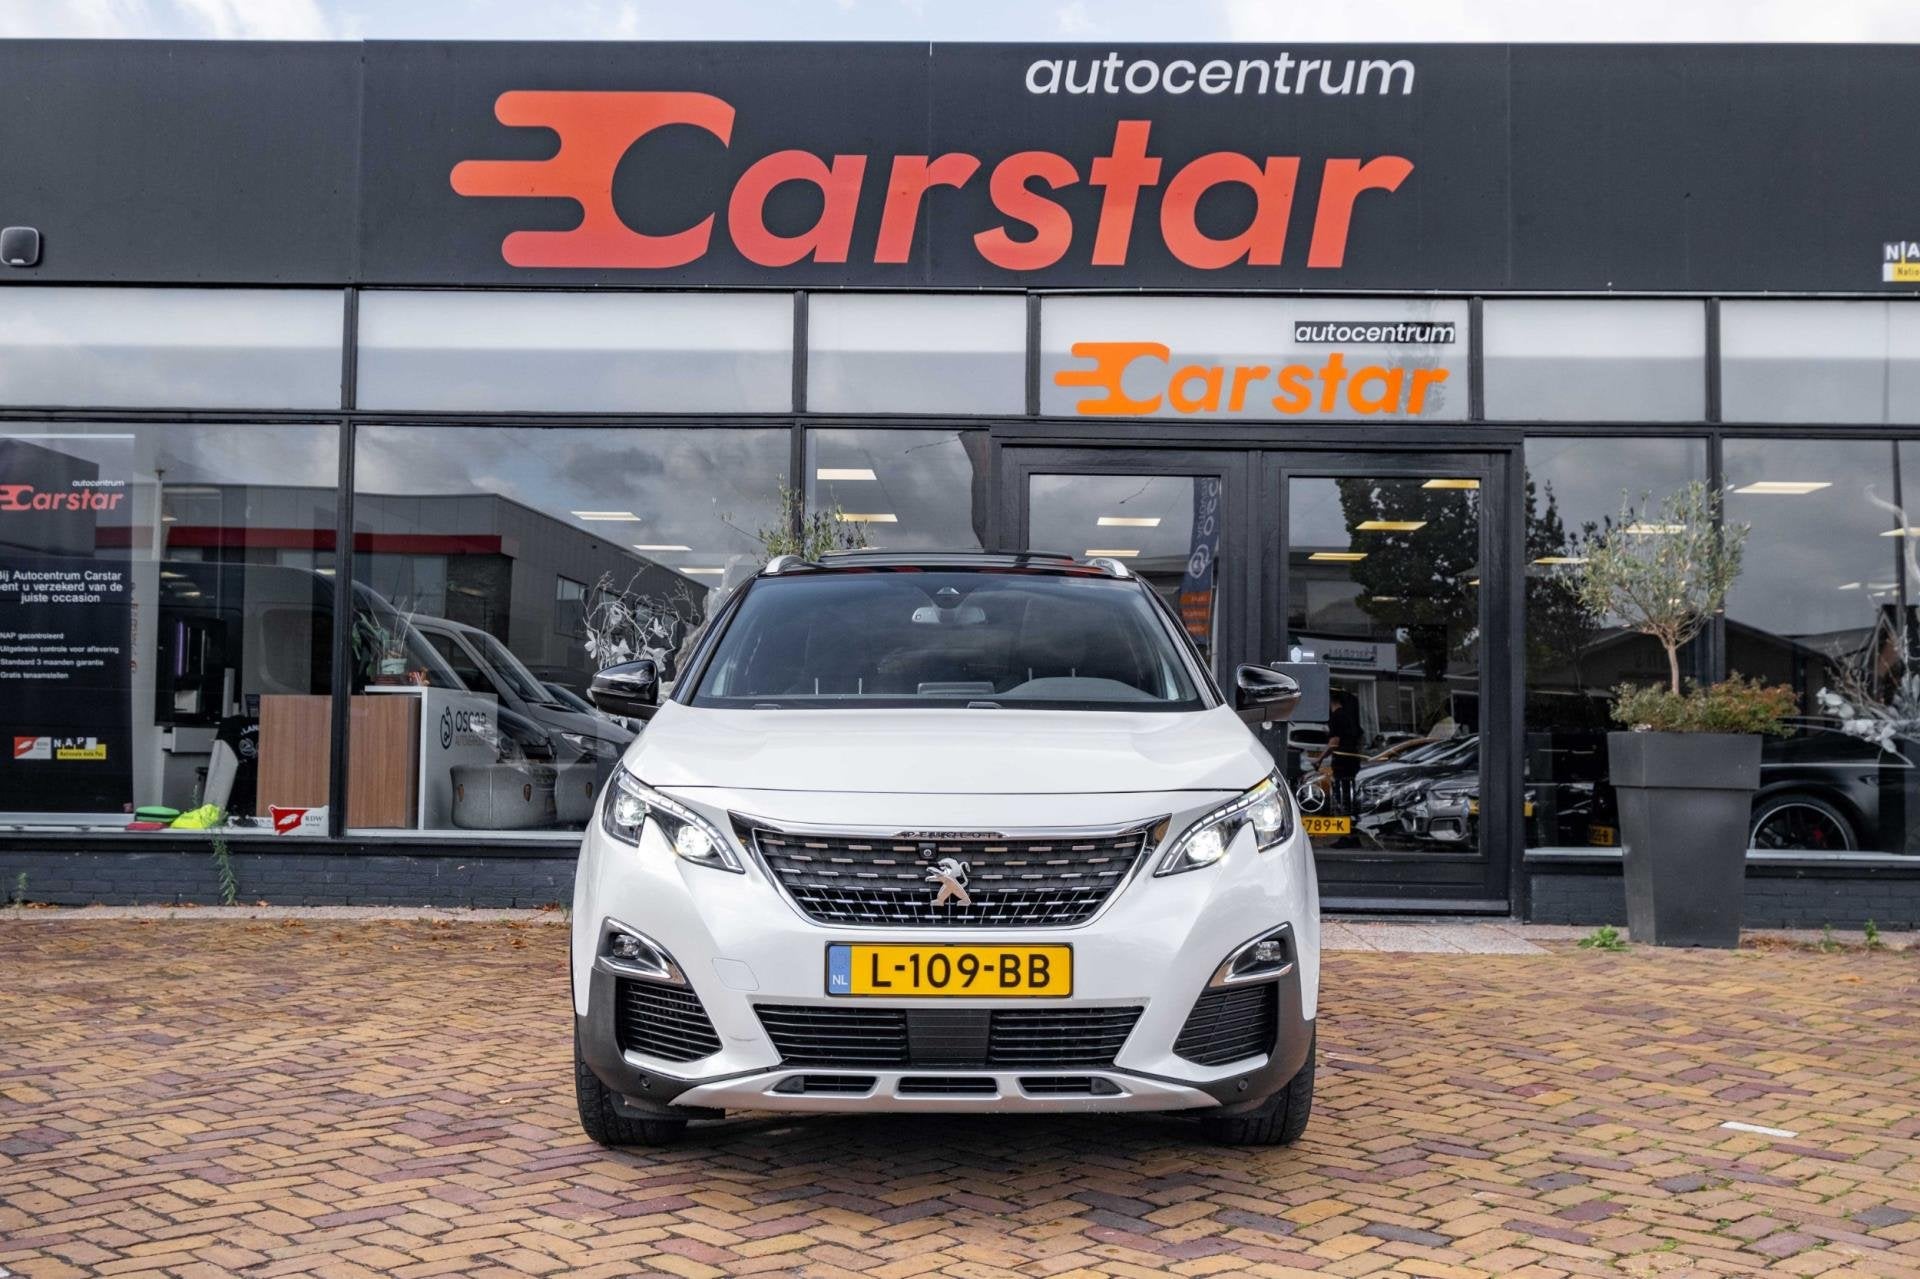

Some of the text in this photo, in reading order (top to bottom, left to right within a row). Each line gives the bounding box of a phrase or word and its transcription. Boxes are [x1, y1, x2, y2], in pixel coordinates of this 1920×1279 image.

[1025, 51, 1415, 96] autocentrum
[450, 90, 1414, 271] Carstar
[1295, 322, 1455, 344] autocentrum
[1054, 342, 1450, 415] Carstar
[0, 484, 124, 511] Carstar
[0, 582, 18, 591] ent
[34, 582, 85, 591] verzekerd
[110, 582, 123, 591] de
[13, 570, 80, 580] Autocentrum
[84, 570, 122, 580] Carstar
[21, 593, 100, 604] juiste occasion
[832, 953, 1051, 988] NL L-109-BB
